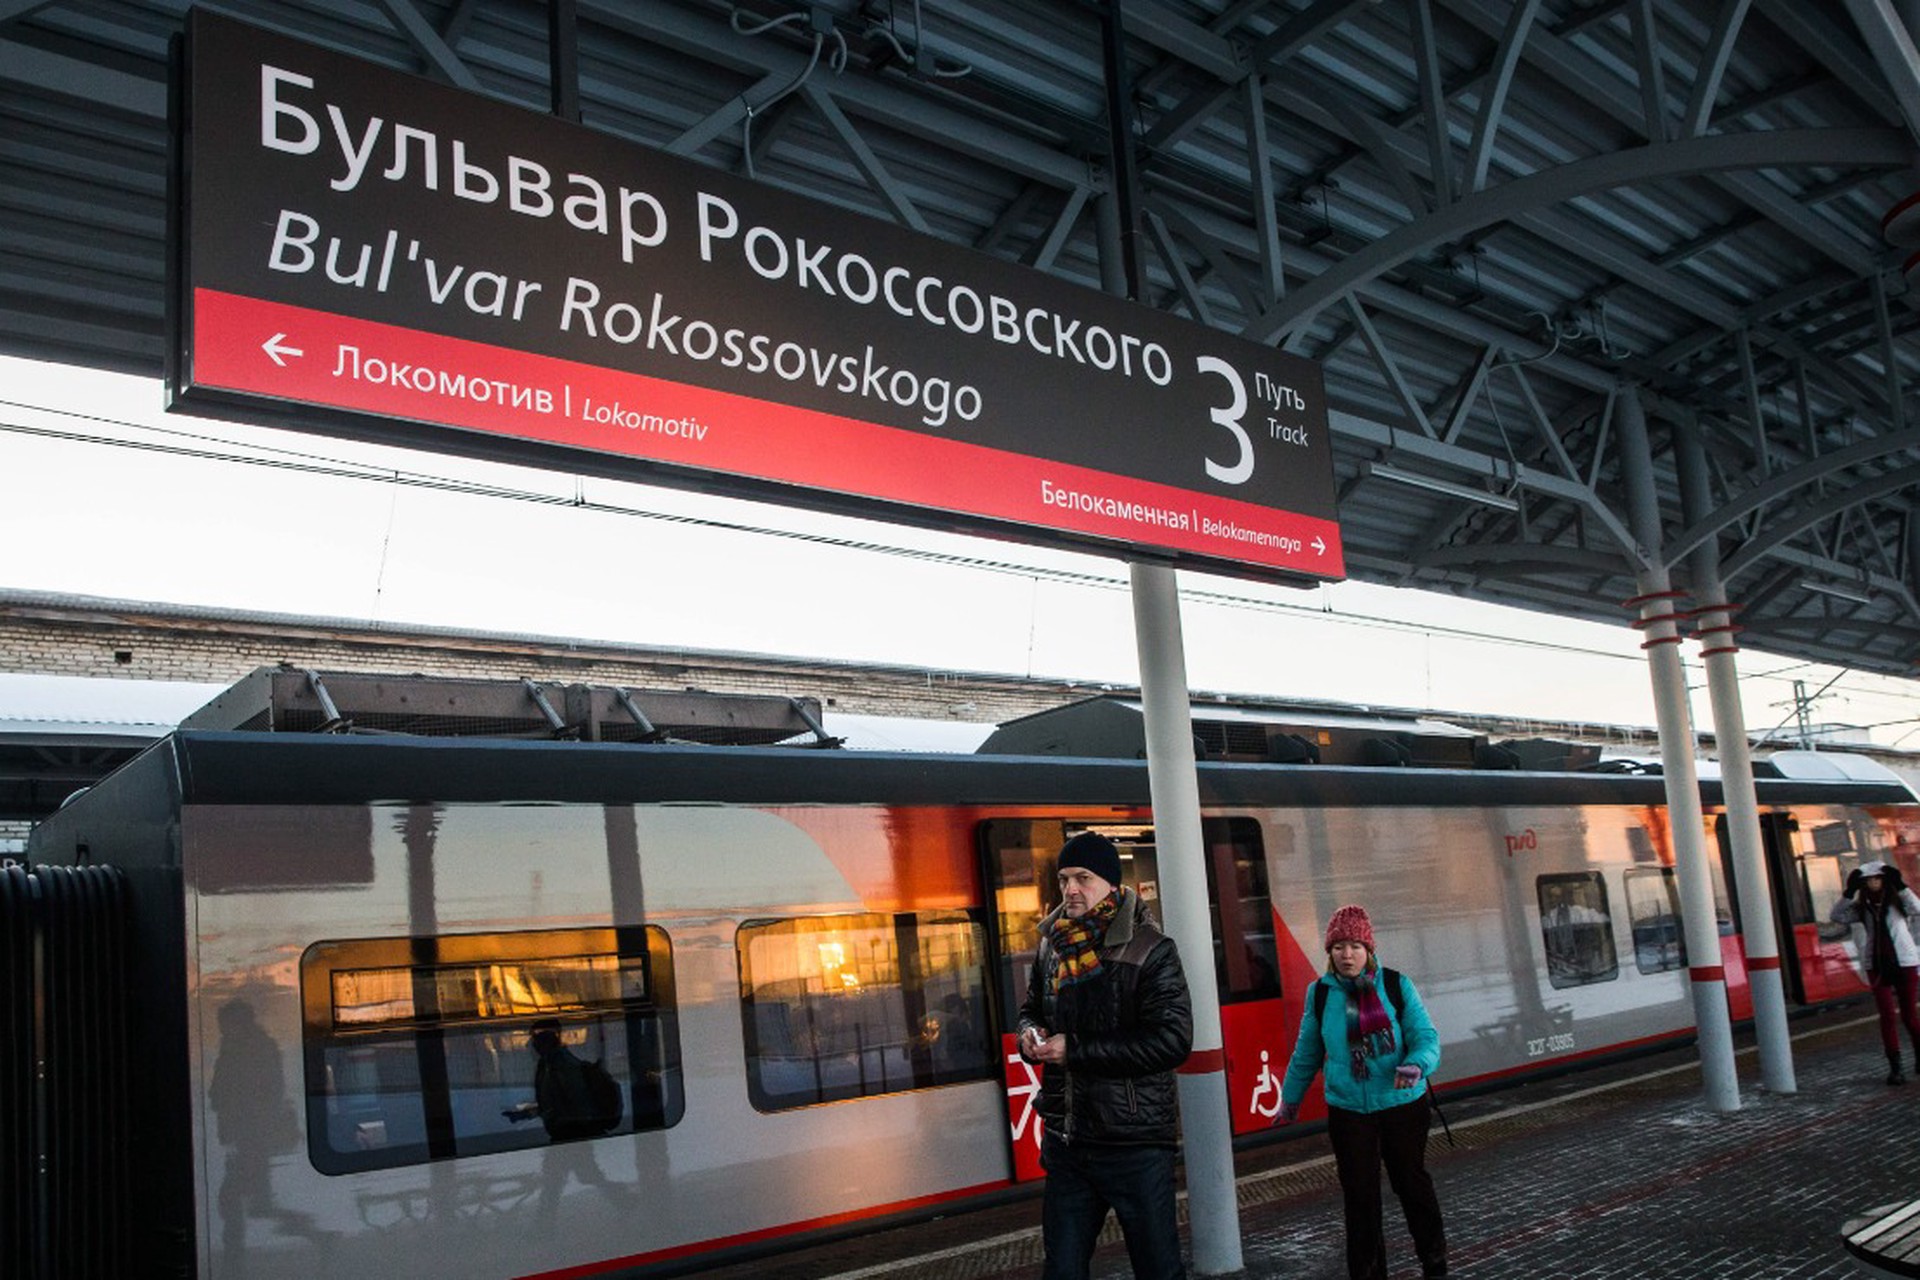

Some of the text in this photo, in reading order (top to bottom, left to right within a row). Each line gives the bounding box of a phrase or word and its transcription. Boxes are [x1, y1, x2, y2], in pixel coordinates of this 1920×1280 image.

[261, 63, 1173, 387] Бульвар Рокоссовского
[267, 208, 984, 428] Bul'var Rokossovskogo
[331, 344, 554, 415] Локомотив
[1255, 371, 1306, 412] Путь
[582, 398, 709, 442] Lokomotiv
[1195, 355, 1256, 486] 3
[1267, 416, 1309, 448] Track
[1040, 479, 1190, 532] Белокаменная
[1202, 517, 1302, 554] Belokamennaya
